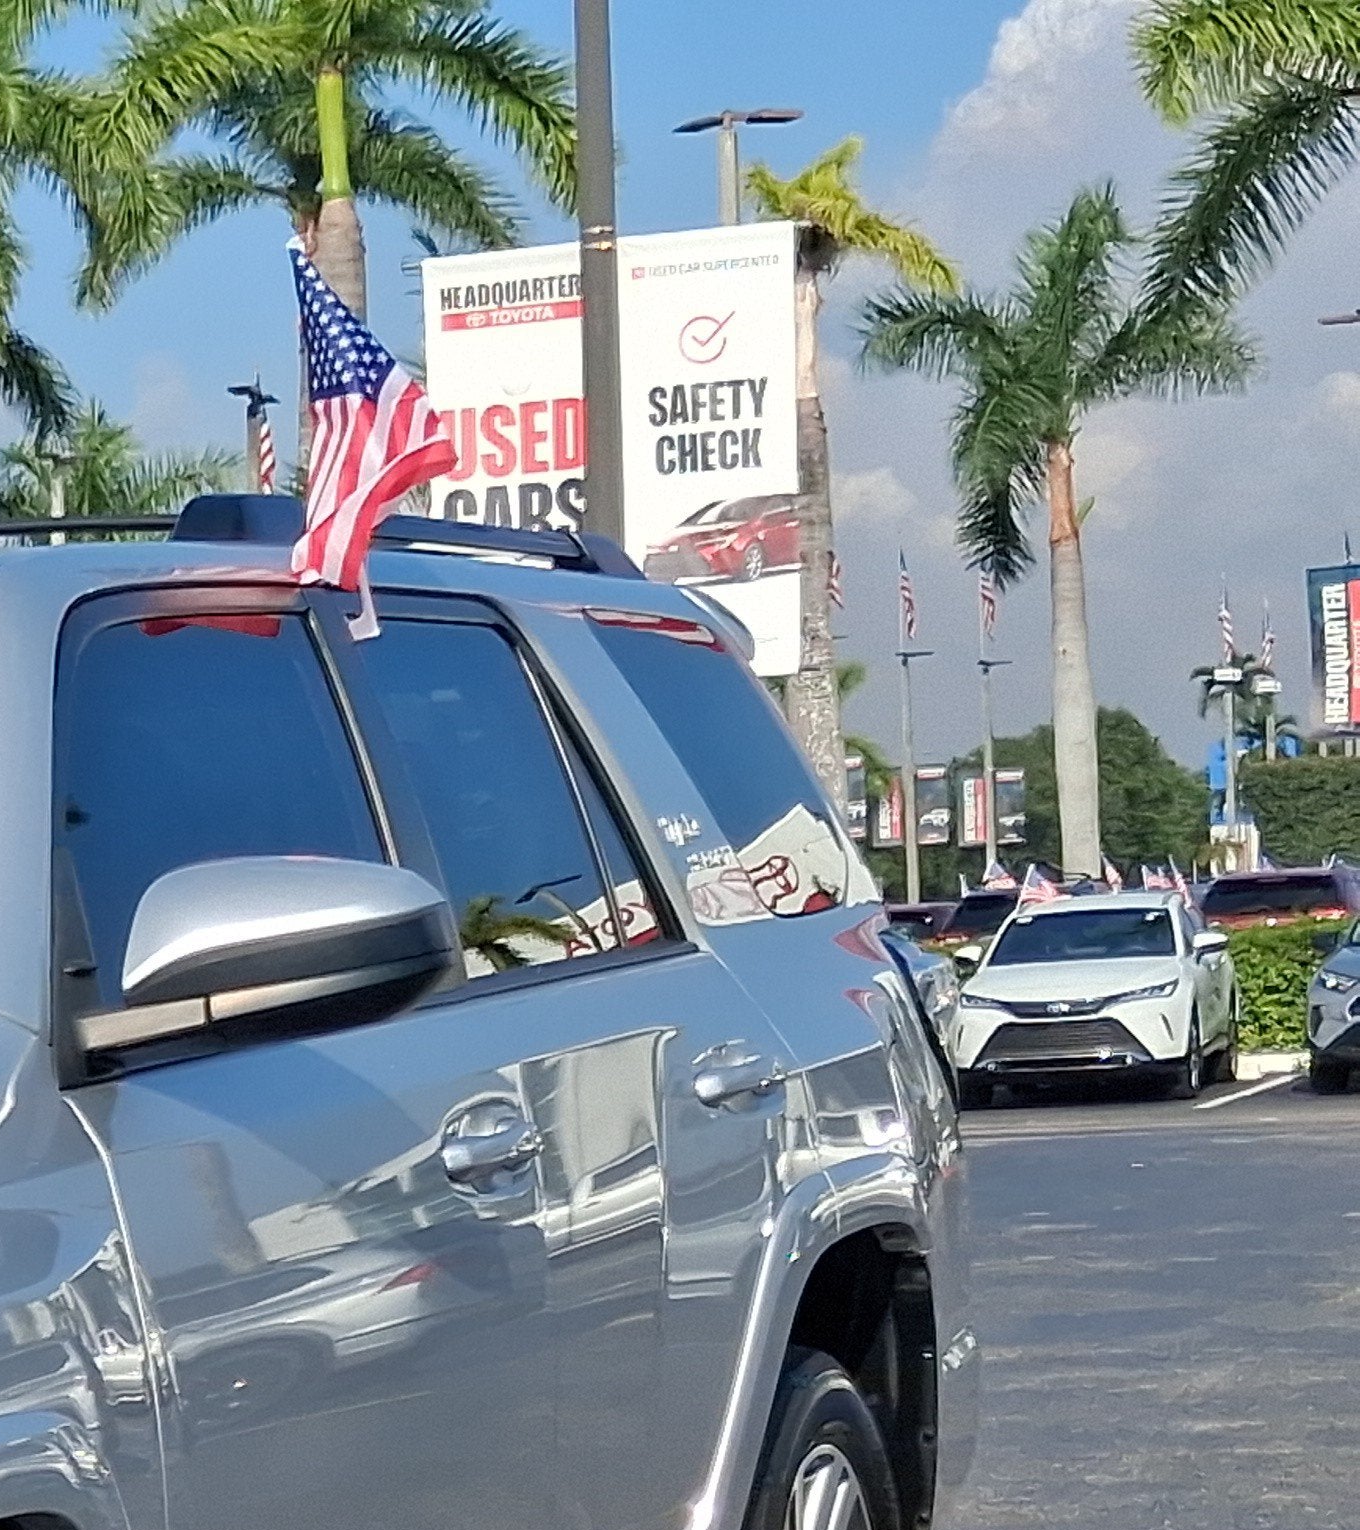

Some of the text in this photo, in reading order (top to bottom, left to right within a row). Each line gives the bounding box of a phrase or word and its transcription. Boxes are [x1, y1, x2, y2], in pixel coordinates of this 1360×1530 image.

[440, 273, 583, 311] HEADQUARTER
[490, 306, 556, 325] TOYOTA
[648, 376, 768, 427] SAFETY
[439, 397, 589, 482] USED
[655, 428, 762, 475] CHECK
[1322, 582, 1351, 724] HEADQUARTER
